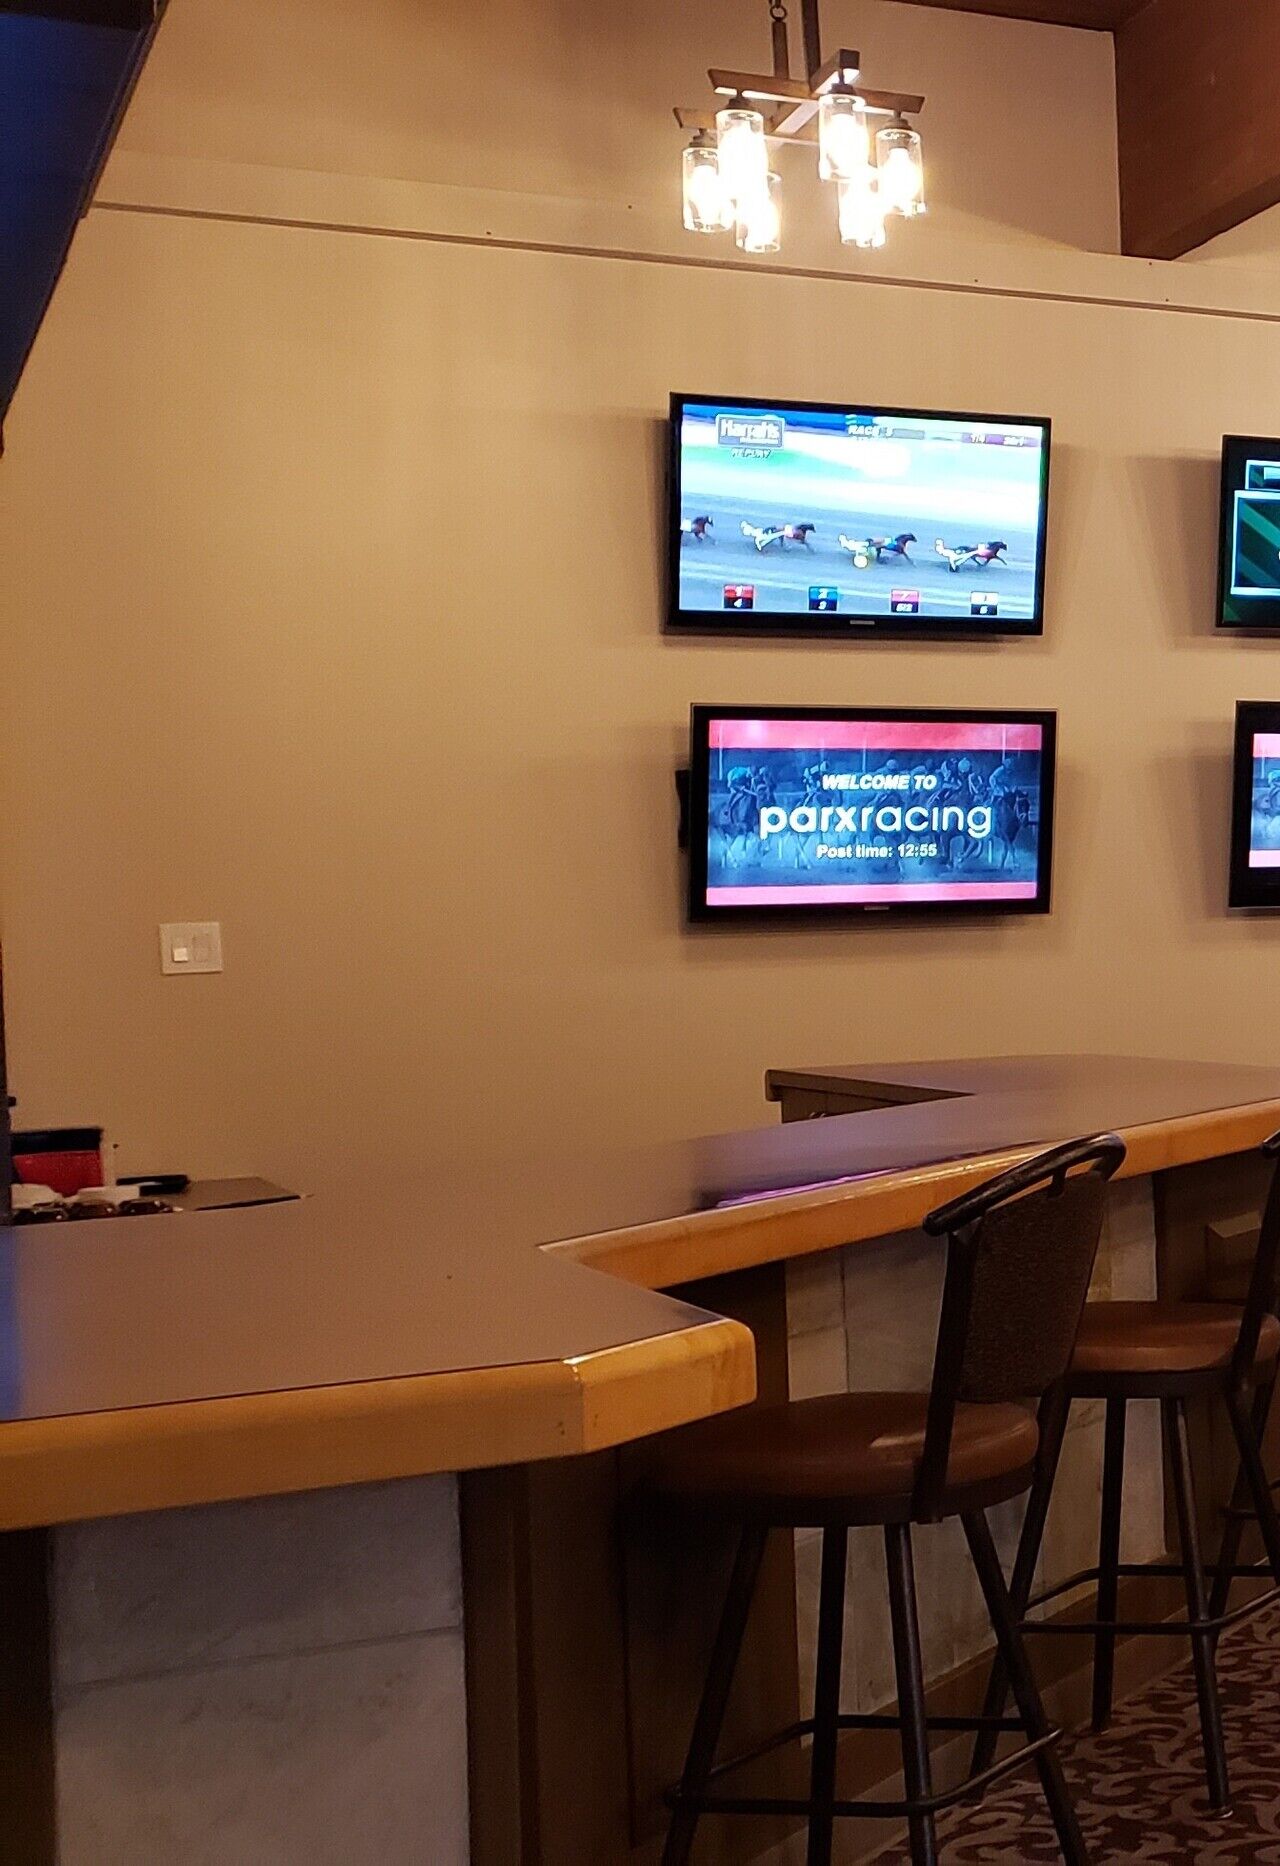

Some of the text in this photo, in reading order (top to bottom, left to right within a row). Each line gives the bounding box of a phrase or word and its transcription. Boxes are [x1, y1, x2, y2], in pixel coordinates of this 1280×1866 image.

[822, 774, 937, 790] WELCOME TO
[816, 843, 938, 859] Post time: 12:55
